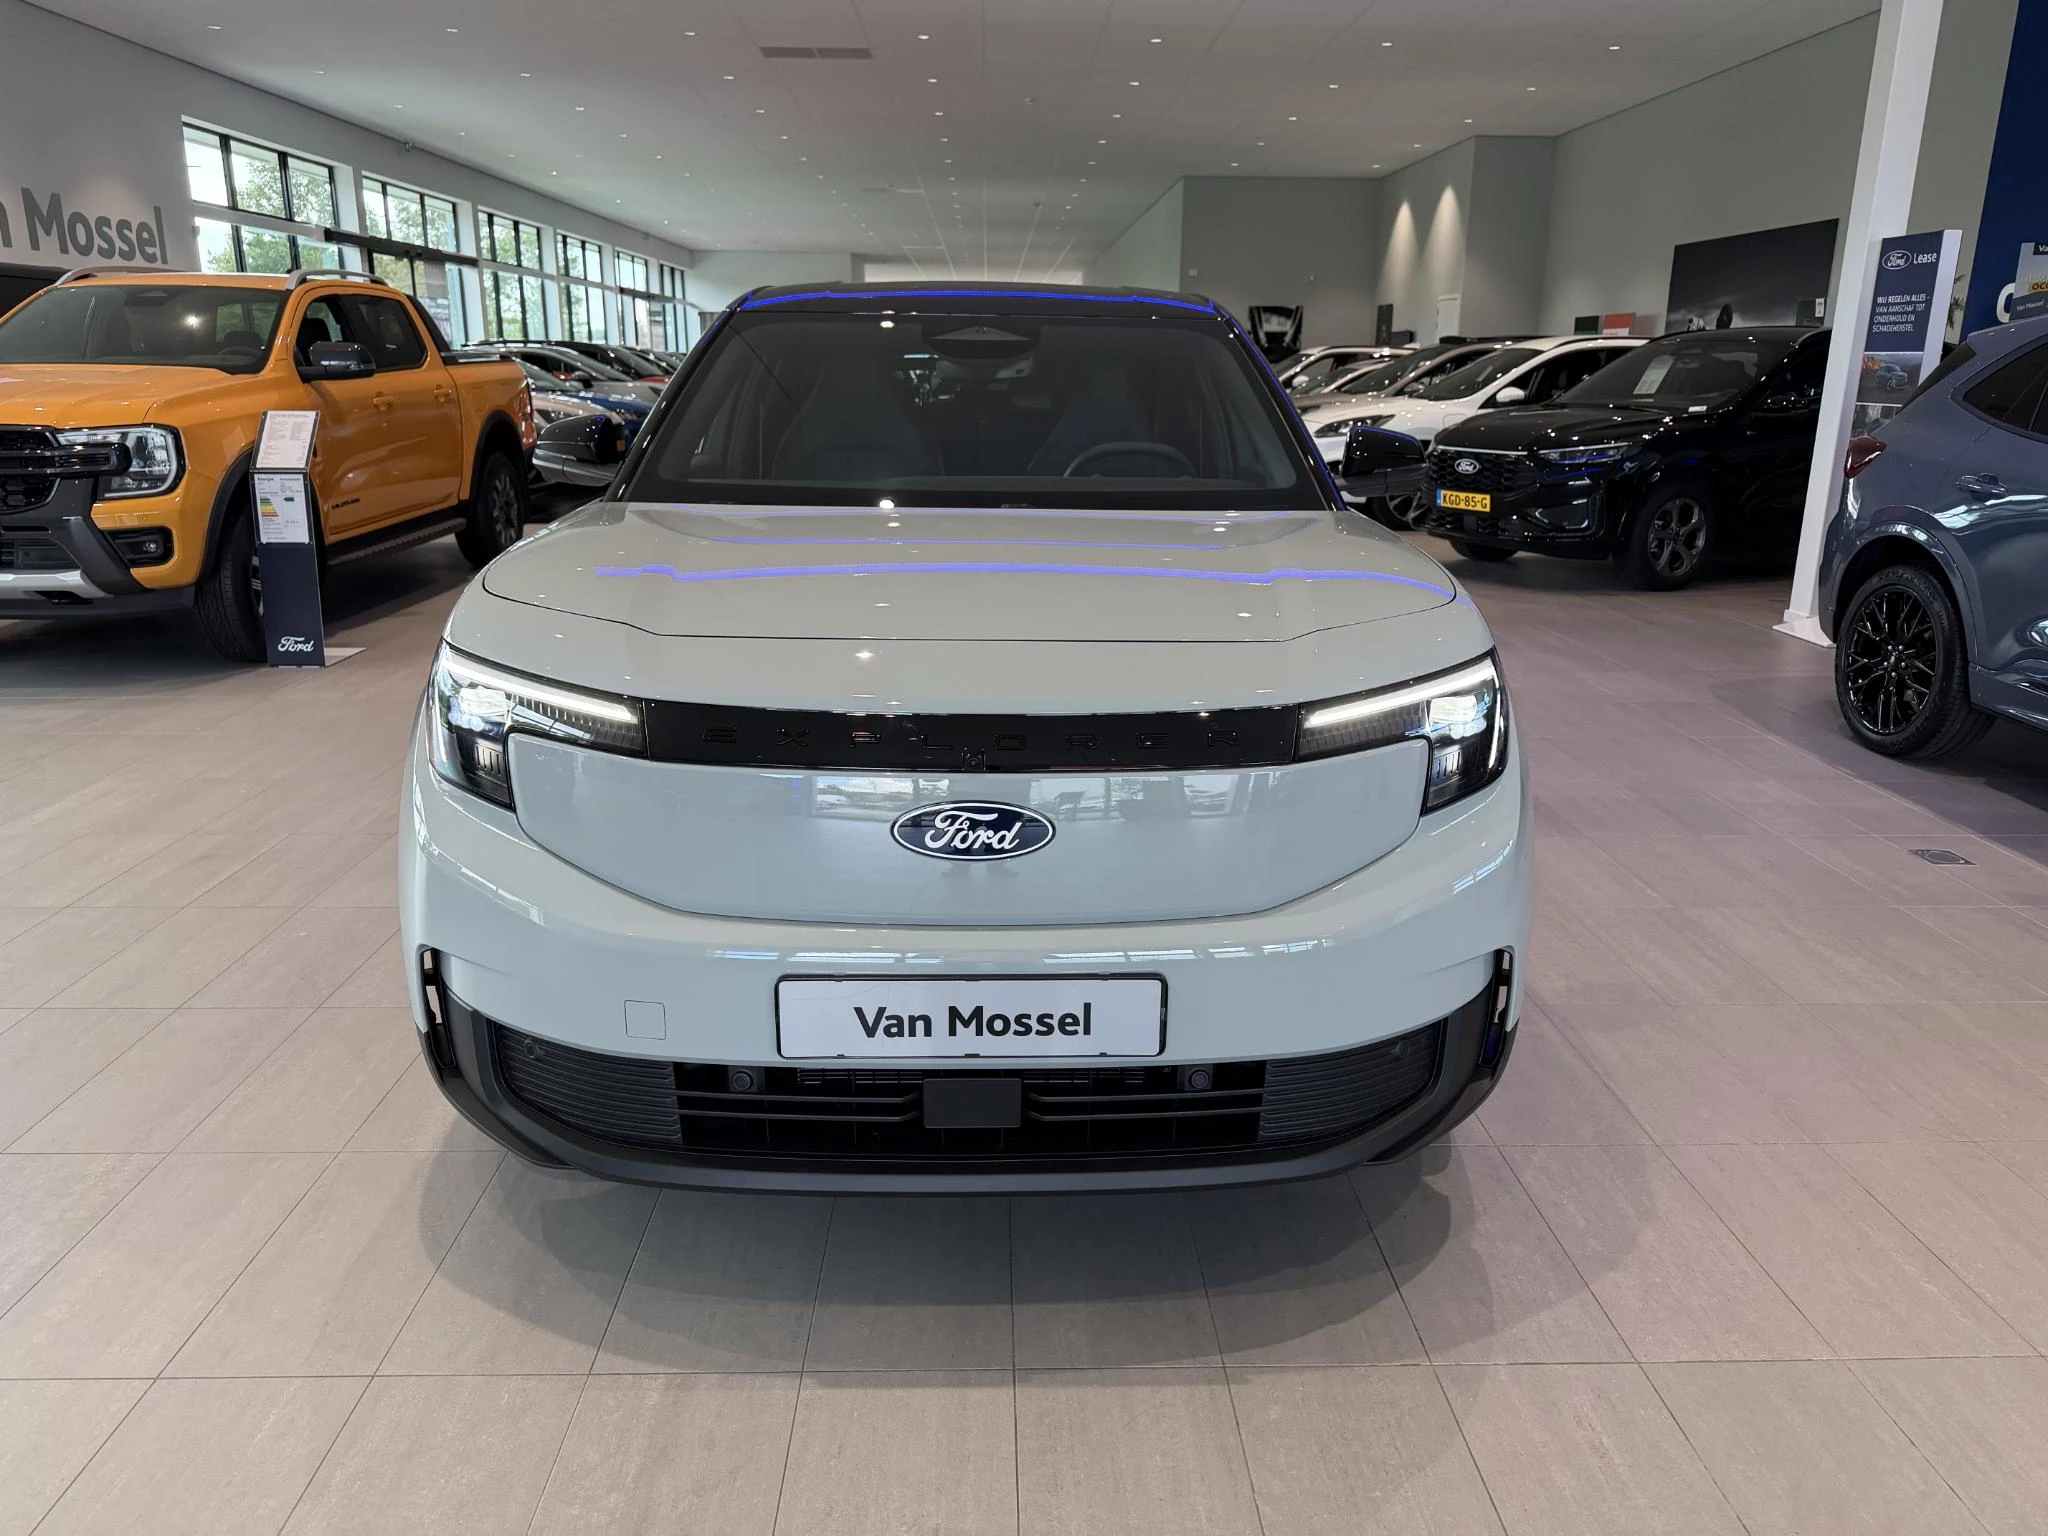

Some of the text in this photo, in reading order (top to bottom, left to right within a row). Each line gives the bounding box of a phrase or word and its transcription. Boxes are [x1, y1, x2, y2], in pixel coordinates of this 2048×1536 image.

[21, 186, 168, 265] Mossel
[1913, 252, 1937, 264] Lease
[1888, 294, 1910, 303] REGELEN
[1911, 293, 1926, 302] ALLES
[1875, 303, 1925, 313] VAN AANSCHAF TOT
[1873, 313, 1915, 323] ONDERHOUD EN
[1872, 323, 1914, 332] SCHADEHERSTEL
[1442, 493, 1488, 509] KGD-85-G
[277, 636, 314, 652] Ford
[702, 725, 1239, 751] EXPLORER
[854, 1002, 1092, 1039] Van Mossel
